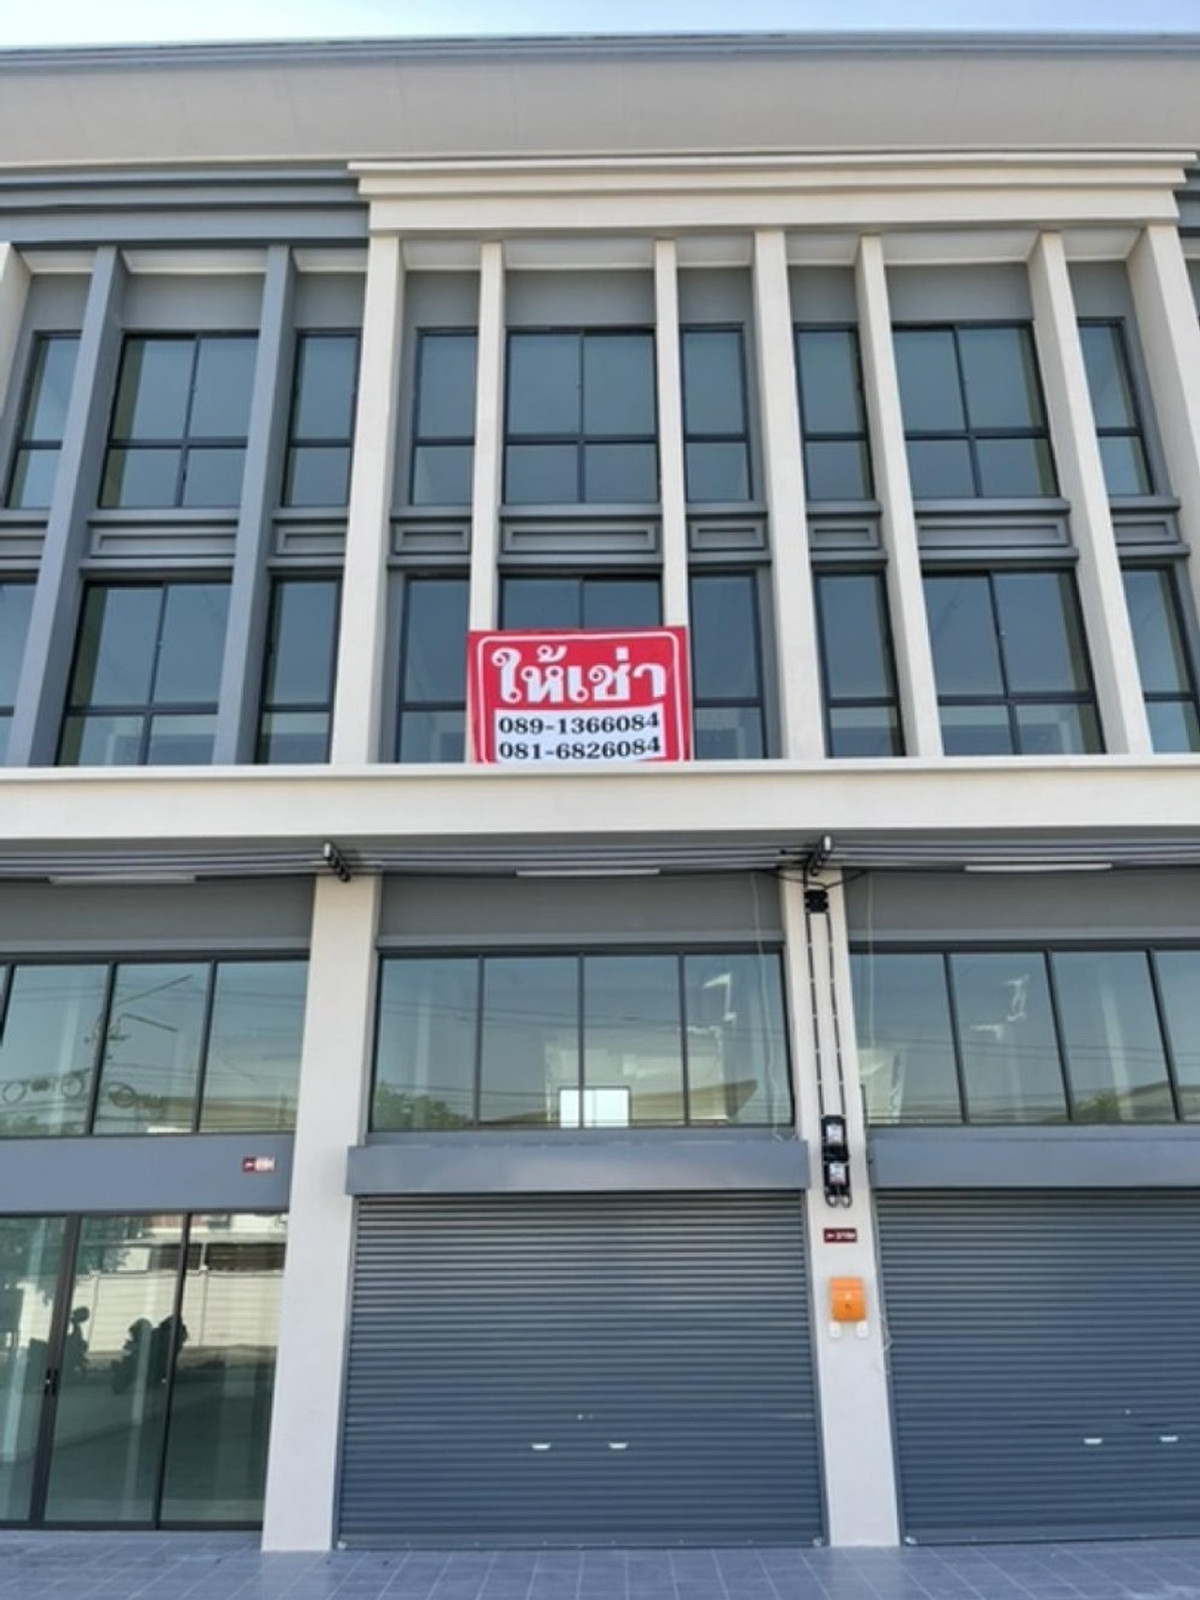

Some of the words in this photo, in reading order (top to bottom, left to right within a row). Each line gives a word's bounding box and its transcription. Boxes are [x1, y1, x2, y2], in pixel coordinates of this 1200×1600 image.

[491, 645, 667, 703] ให้เช่า
[499, 711, 659, 735] 089-1366084
[499, 736, 661, 760] 081-6826084
